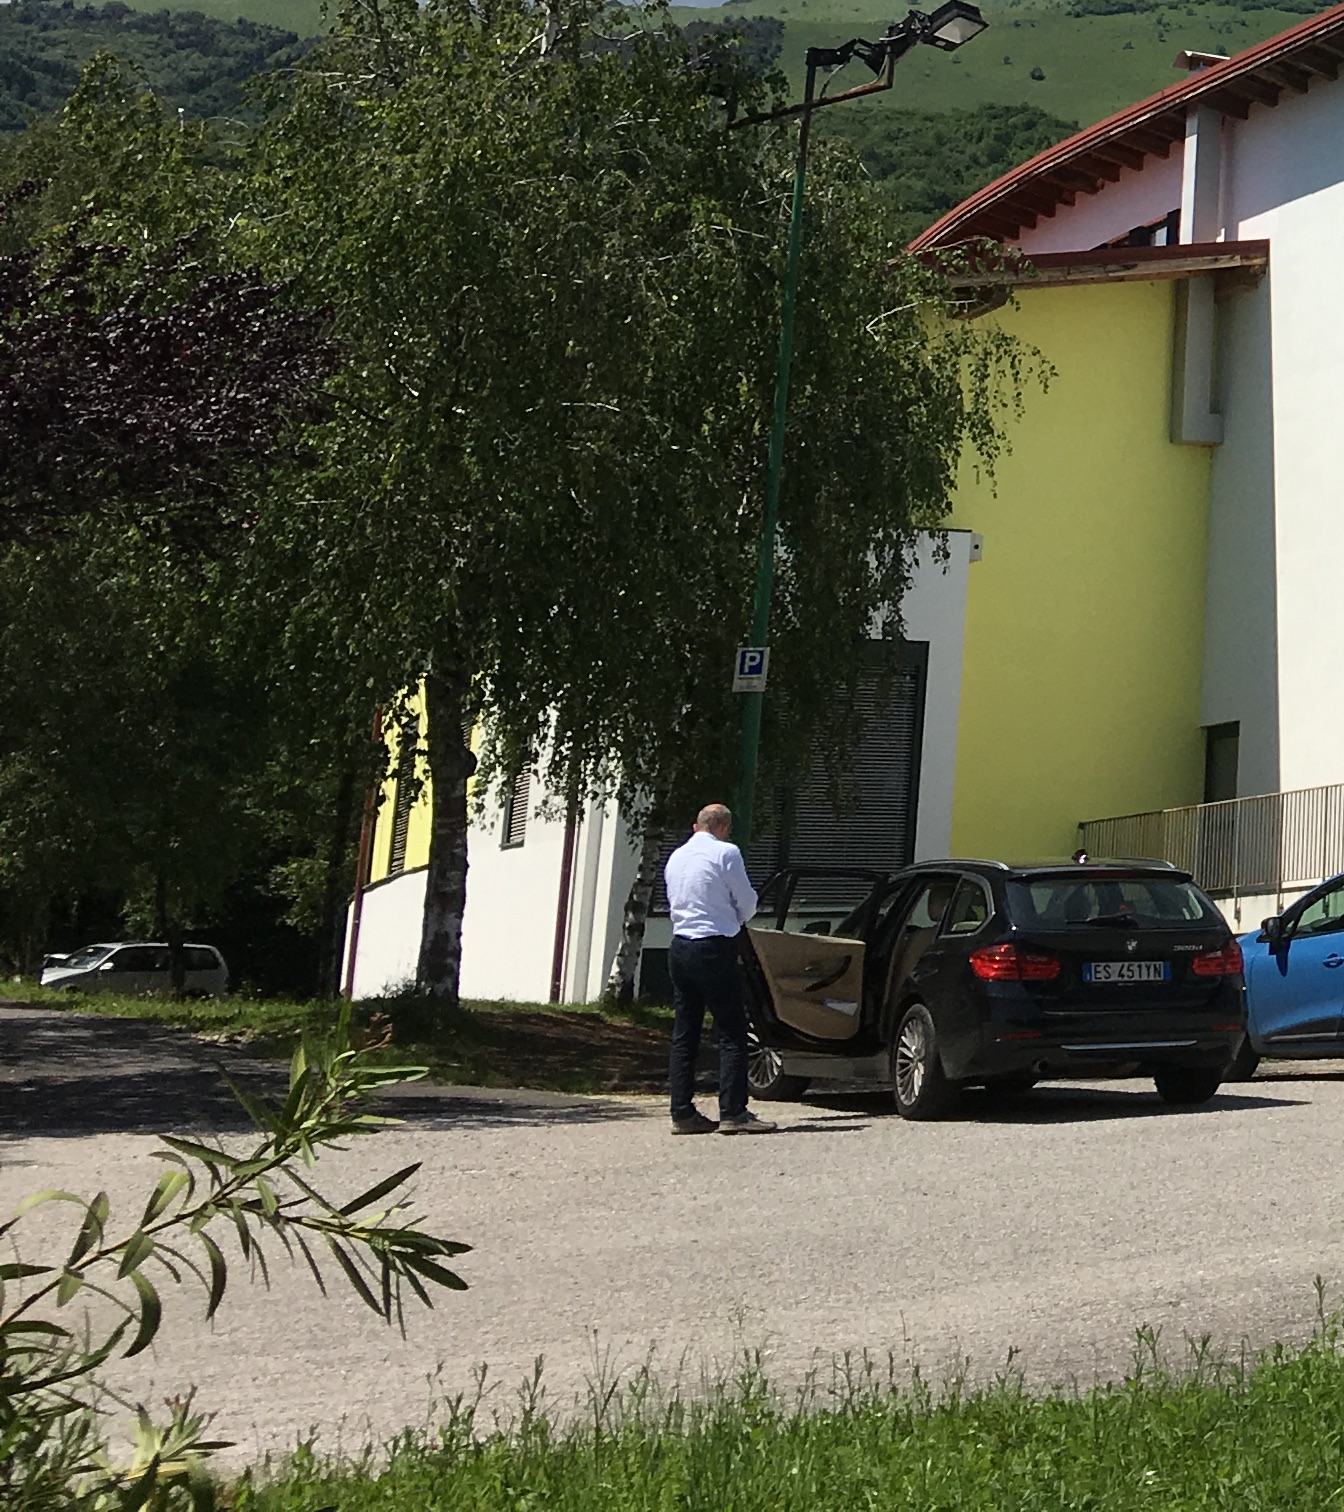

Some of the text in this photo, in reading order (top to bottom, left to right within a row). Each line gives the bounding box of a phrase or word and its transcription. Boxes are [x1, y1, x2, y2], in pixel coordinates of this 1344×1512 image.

[743, 652, 760, 673] P
[1093, 962, 1163, 980] ES 451YN
